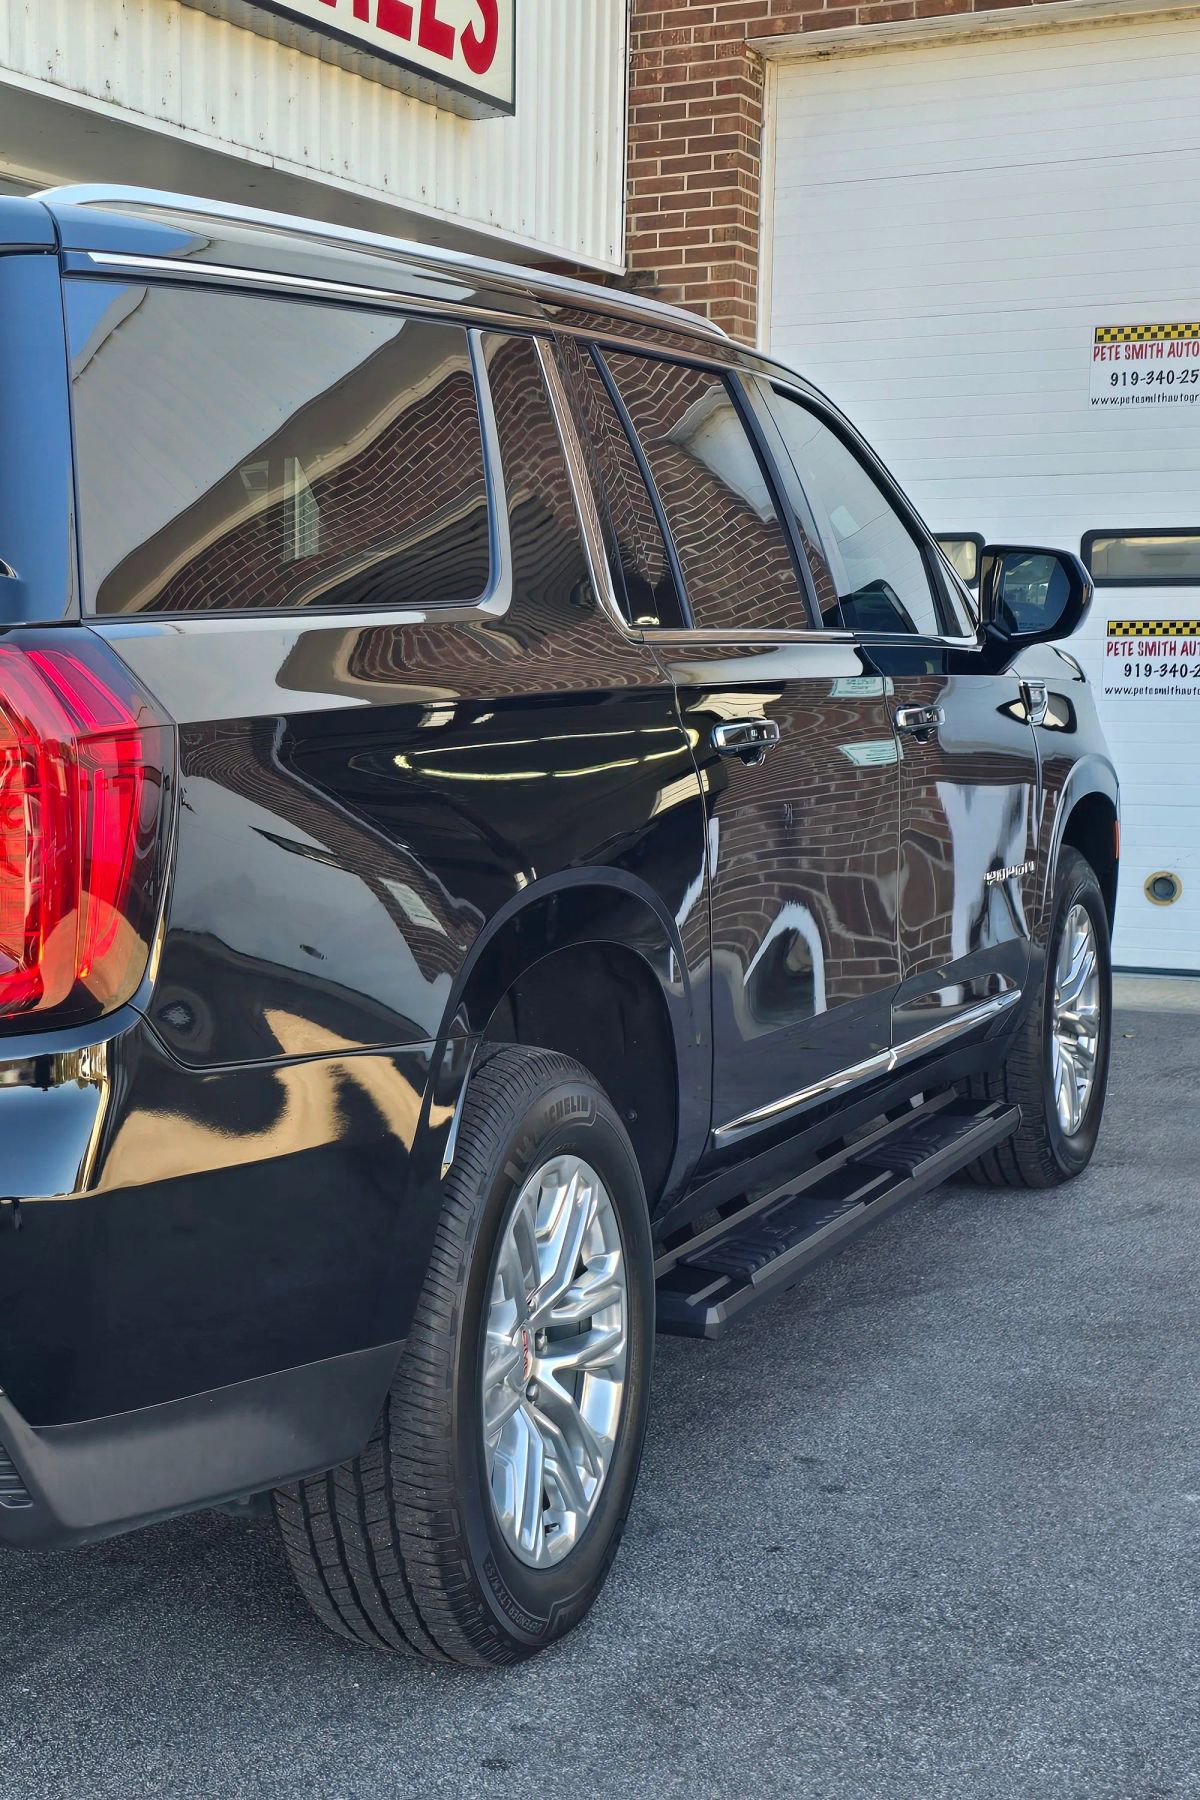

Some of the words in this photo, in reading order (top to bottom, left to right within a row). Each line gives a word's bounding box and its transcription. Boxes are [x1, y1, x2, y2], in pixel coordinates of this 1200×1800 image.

[1093, 344, 1121, 362] PETE
[1124, 342, 1164, 360] SMITH
[1167, 340, 1200, 358] AUTO
[1110, 369, 1200, 387] 919-340-25
[1106, 640, 1134, 657] PETE
[1137, 640, 1177, 657] SMITH
[1124, 663, 1200, 678] 919-340-2
